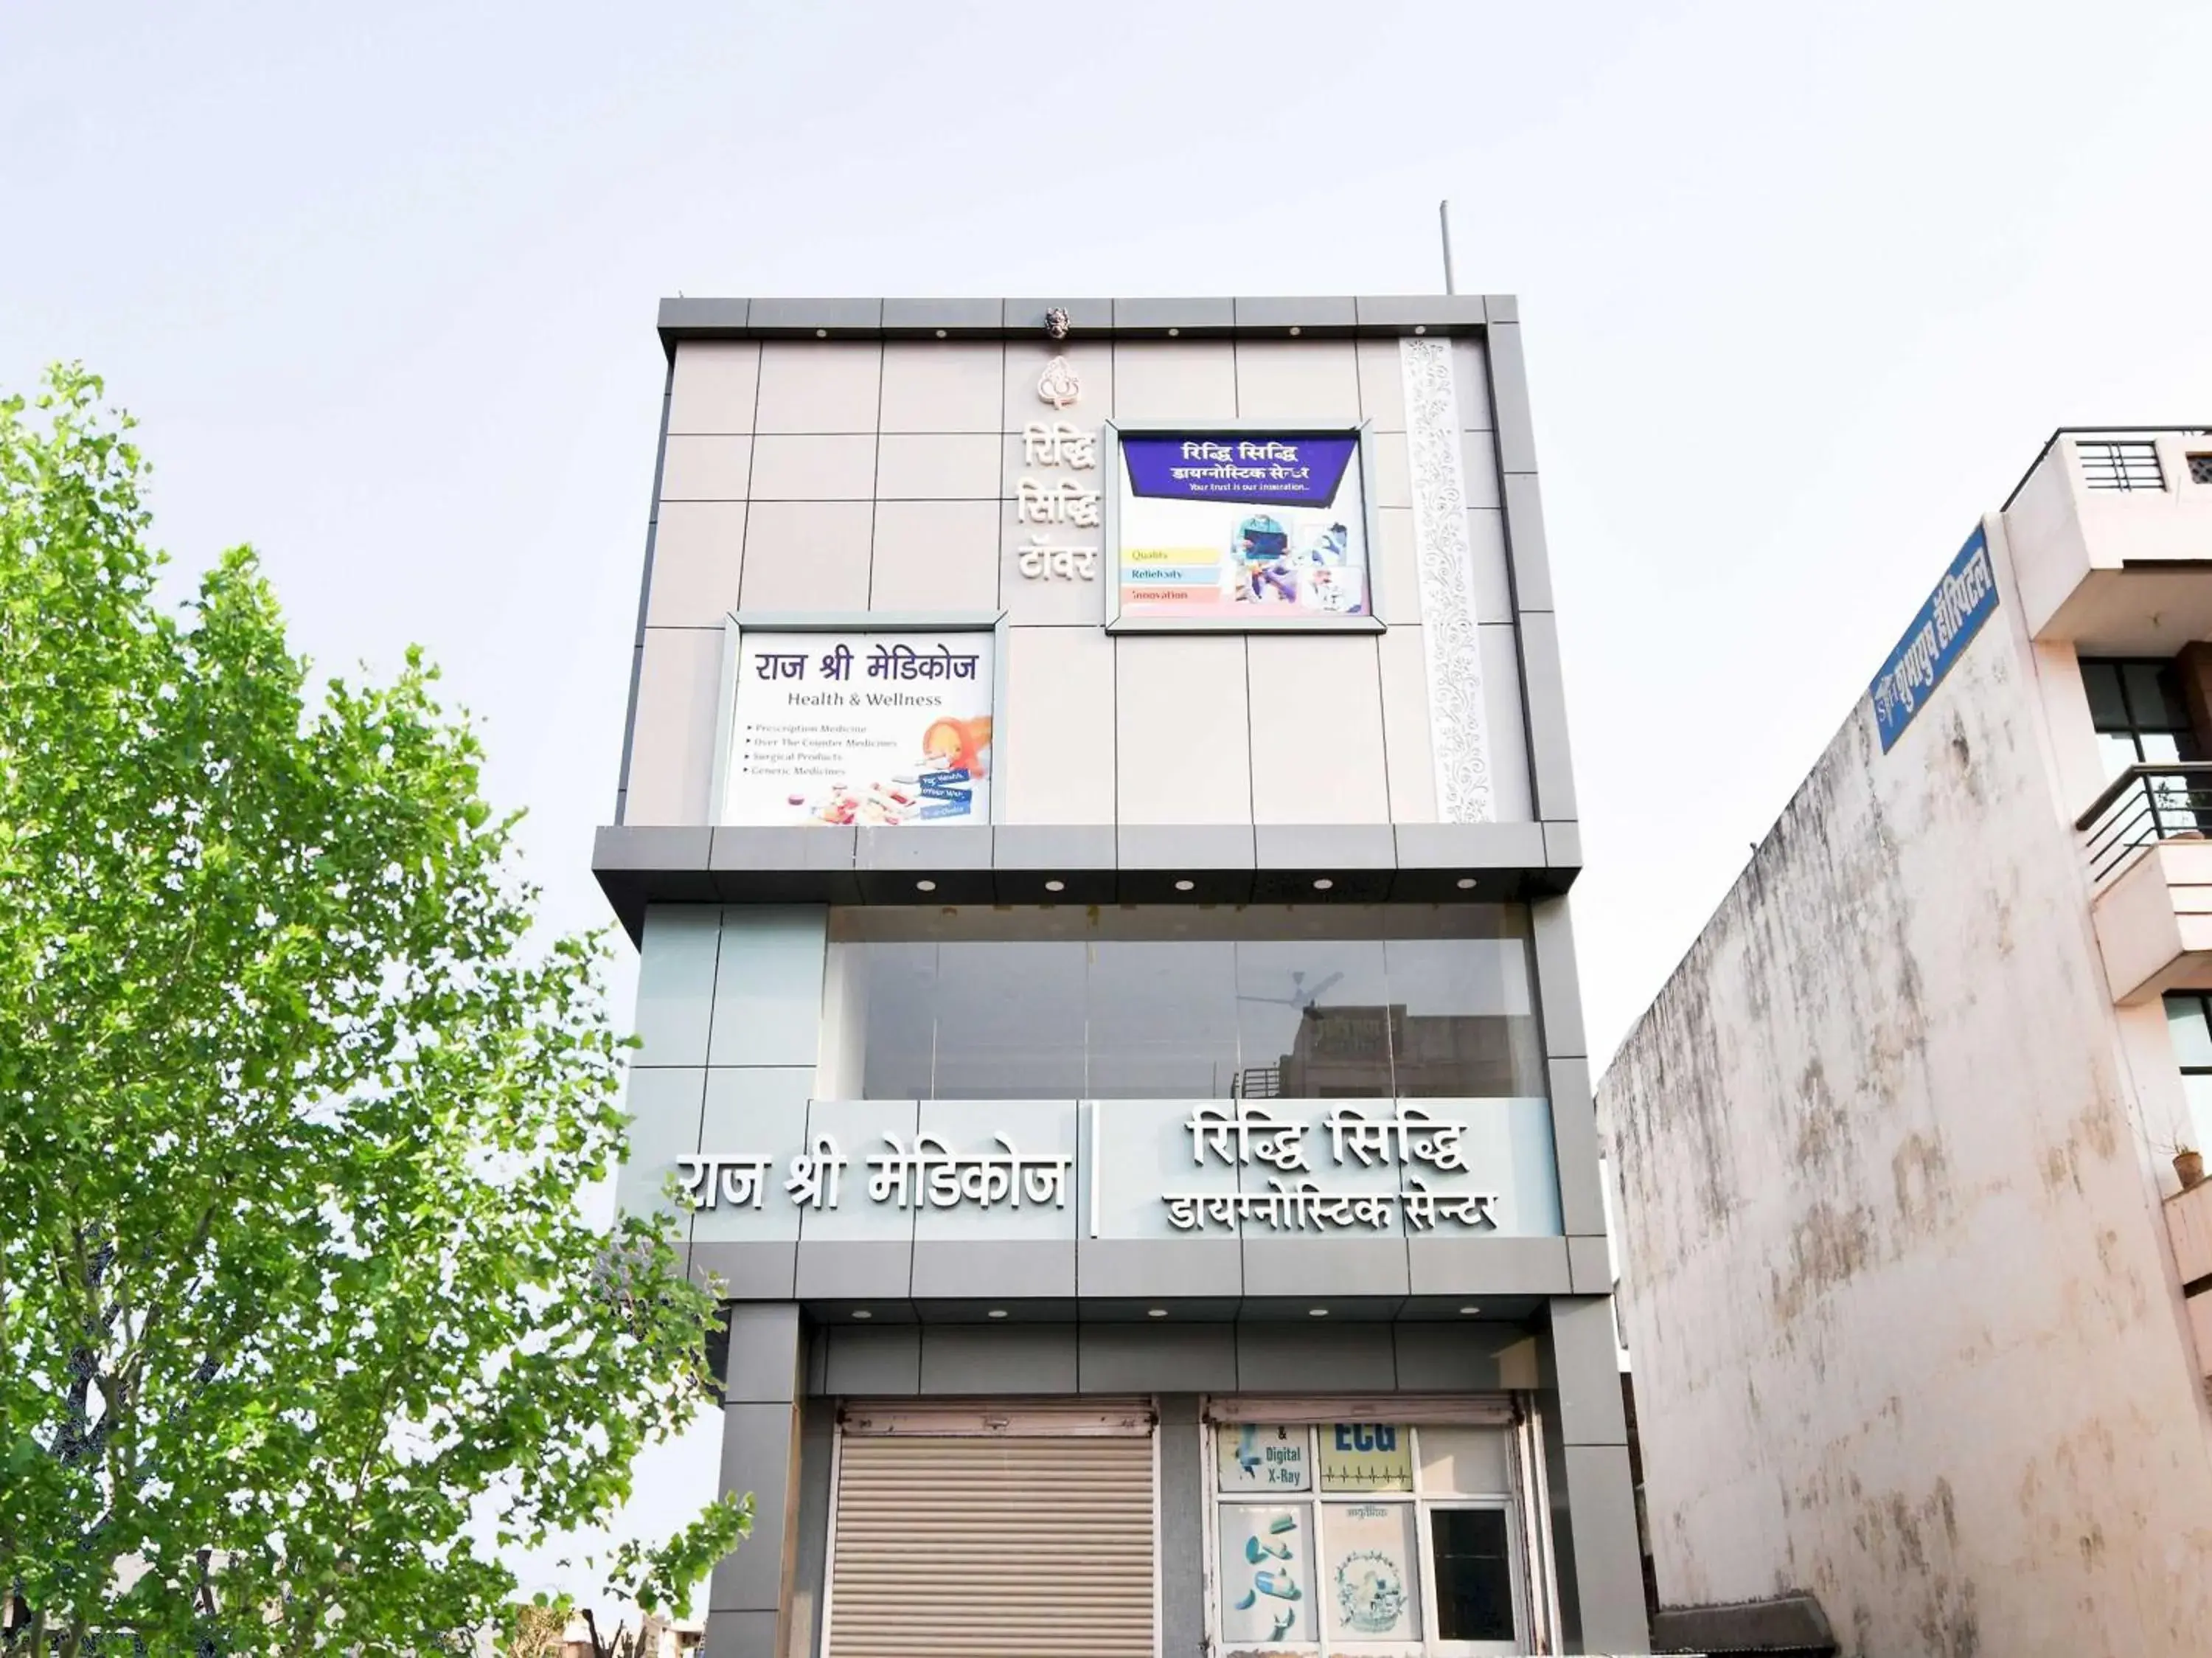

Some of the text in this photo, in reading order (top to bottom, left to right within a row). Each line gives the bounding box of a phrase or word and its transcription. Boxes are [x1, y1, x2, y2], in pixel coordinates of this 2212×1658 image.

[1022, 421, 1096, 470] रिद्धि
[1180, 441, 1298, 462] रिद्धि सिद्धि
[1169, 463, 1266, 479] डायग्नोस्टिक
[1015, 479, 1101, 529] सिद्धि
[1018, 534, 1097, 580] टॉवर
[1933, 547, 1992, 651] हॉस्पिटल
[755, 643, 979, 681] राज श्री मेडिकोज
[787, 692, 943, 707] Health & Wellness
[755, 724, 817, 735] Prescription
[754, 738, 778, 747] Over
[782, 738, 799, 747] The
[801, 738, 843, 747] Counter
[797, 752, 843, 761] Products
[793, 766, 846, 776] Medicines
[1185, 1103, 1471, 1172] रिद्धि सिद्धि
[676, 1129, 1074, 1210] राज श्री मेडिकोज
[1161, 1175, 1499, 1232] डायग्नोस्टिक सेन्टर
[1278, 1426, 1287, 1440] &
[1335, 1423, 1396, 1452] ECG
[1265, 1446, 1301, 1465] Digital
[1268, 1468, 1301, 1486] X-Ray
